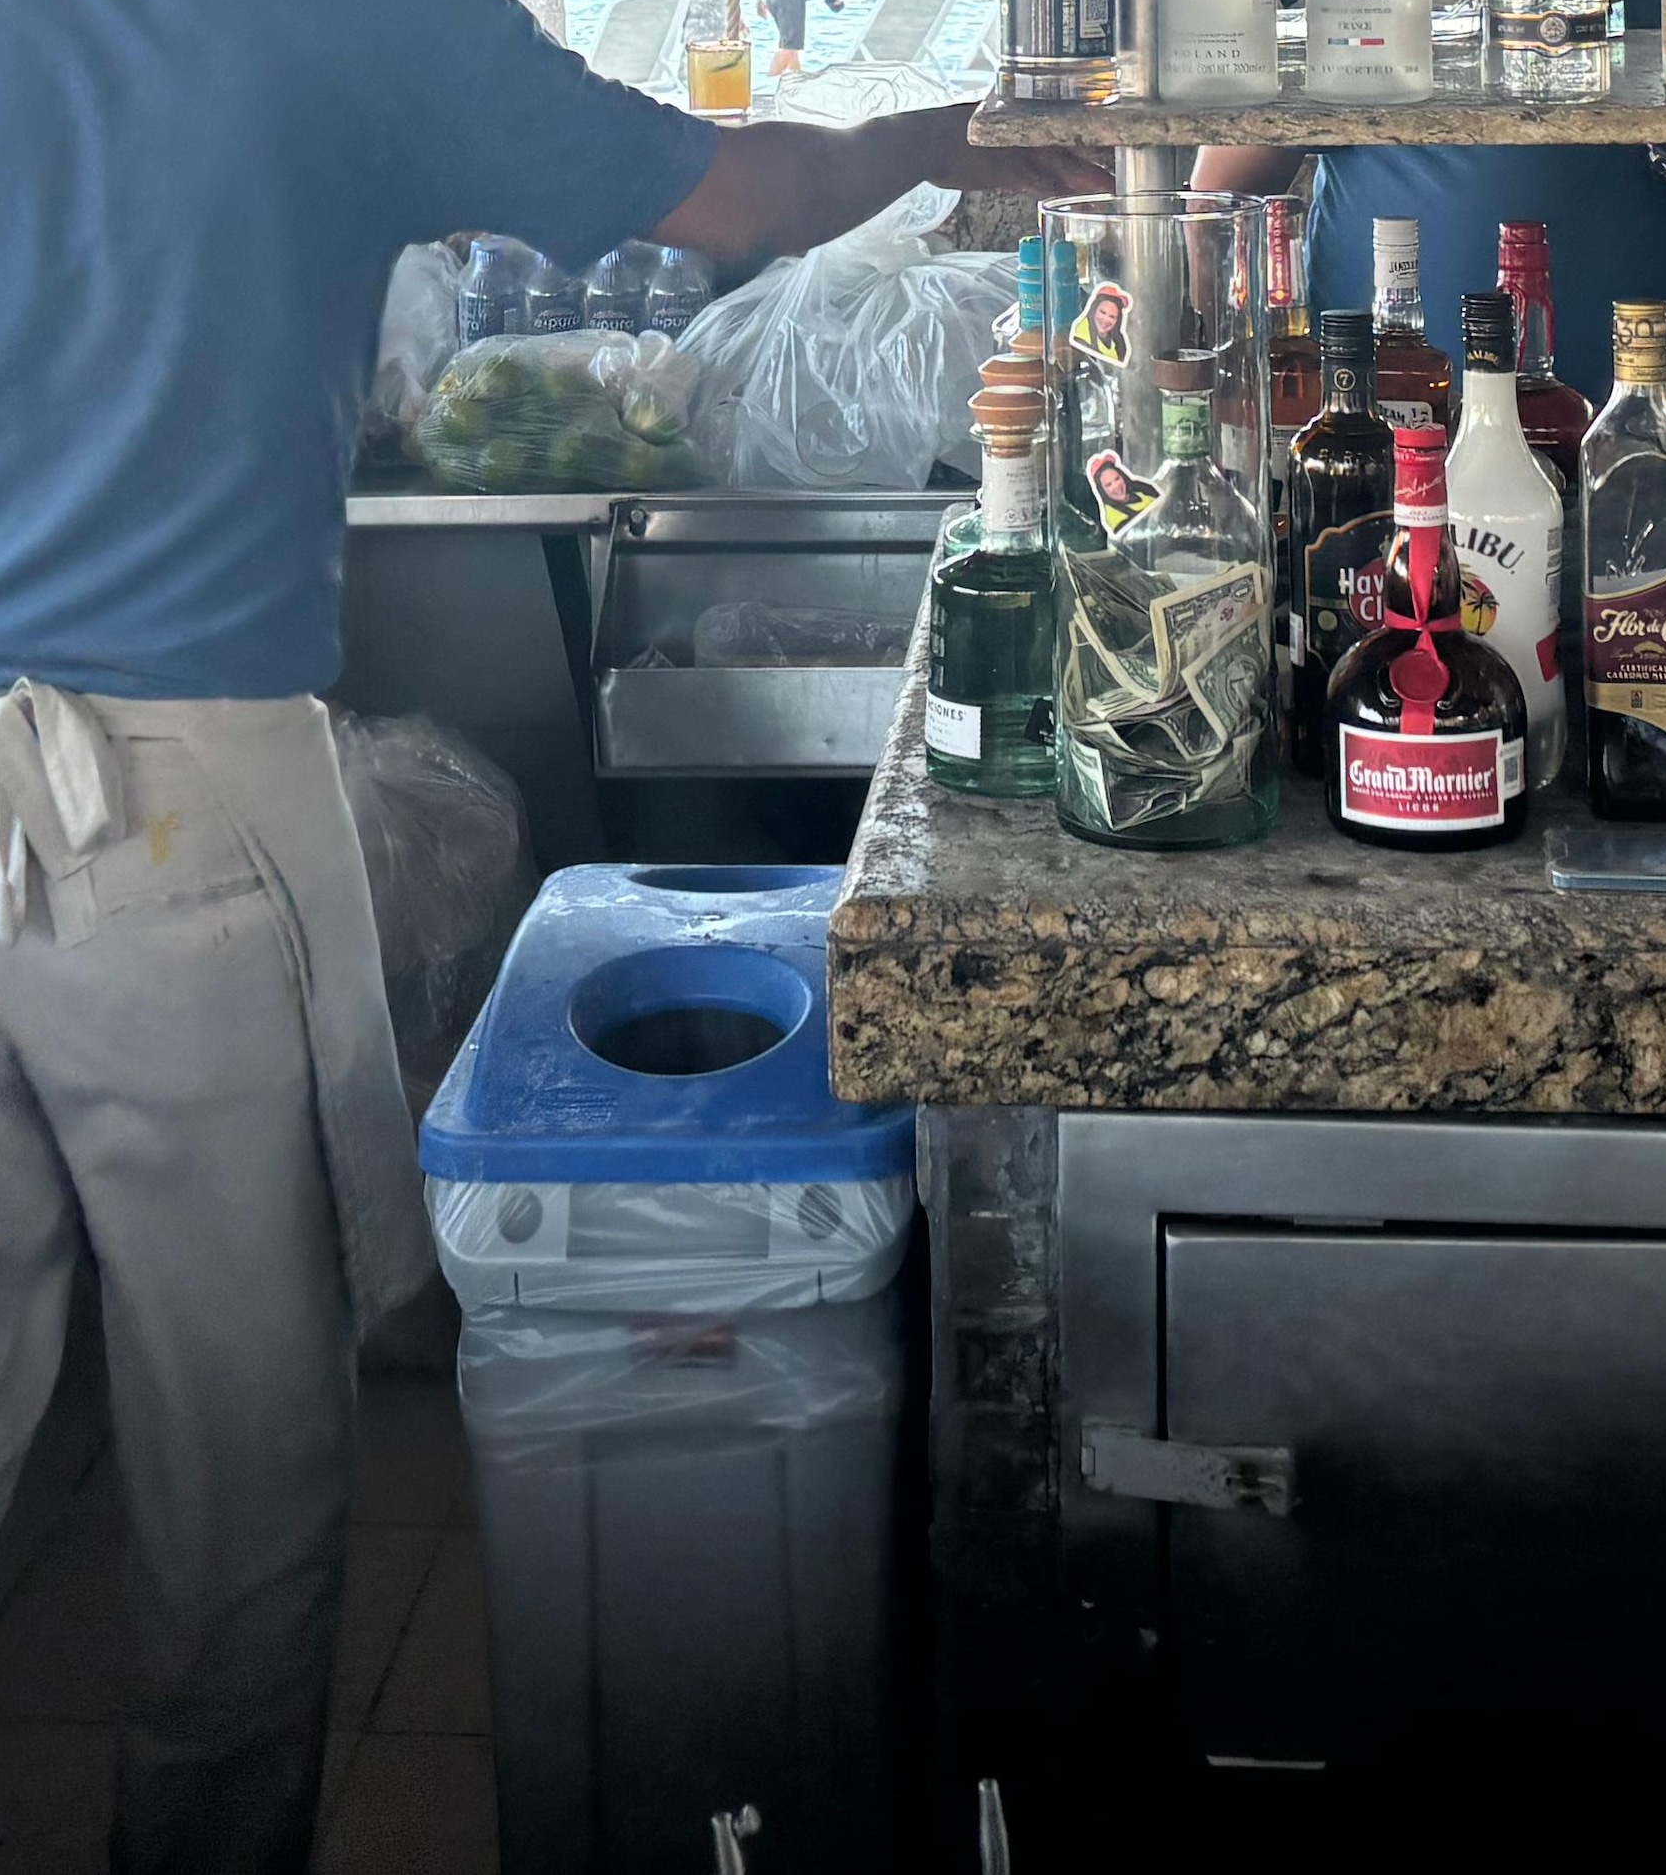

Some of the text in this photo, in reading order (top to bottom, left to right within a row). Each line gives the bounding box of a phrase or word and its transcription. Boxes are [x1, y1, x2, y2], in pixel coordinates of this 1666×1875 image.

[1340, 373, 1349, 386] 7
[1450, 523, 1525, 575] LIBU.
[1338, 567, 1384, 595] Hav
[1359, 595, 1383, 621] Cl
[1593, 608, 1646, 643] Flor
[1647, 617, 1660, 633] de
[1349, 759, 1407, 788] Grand
[1406, 766, 1491, 794] Marnier
